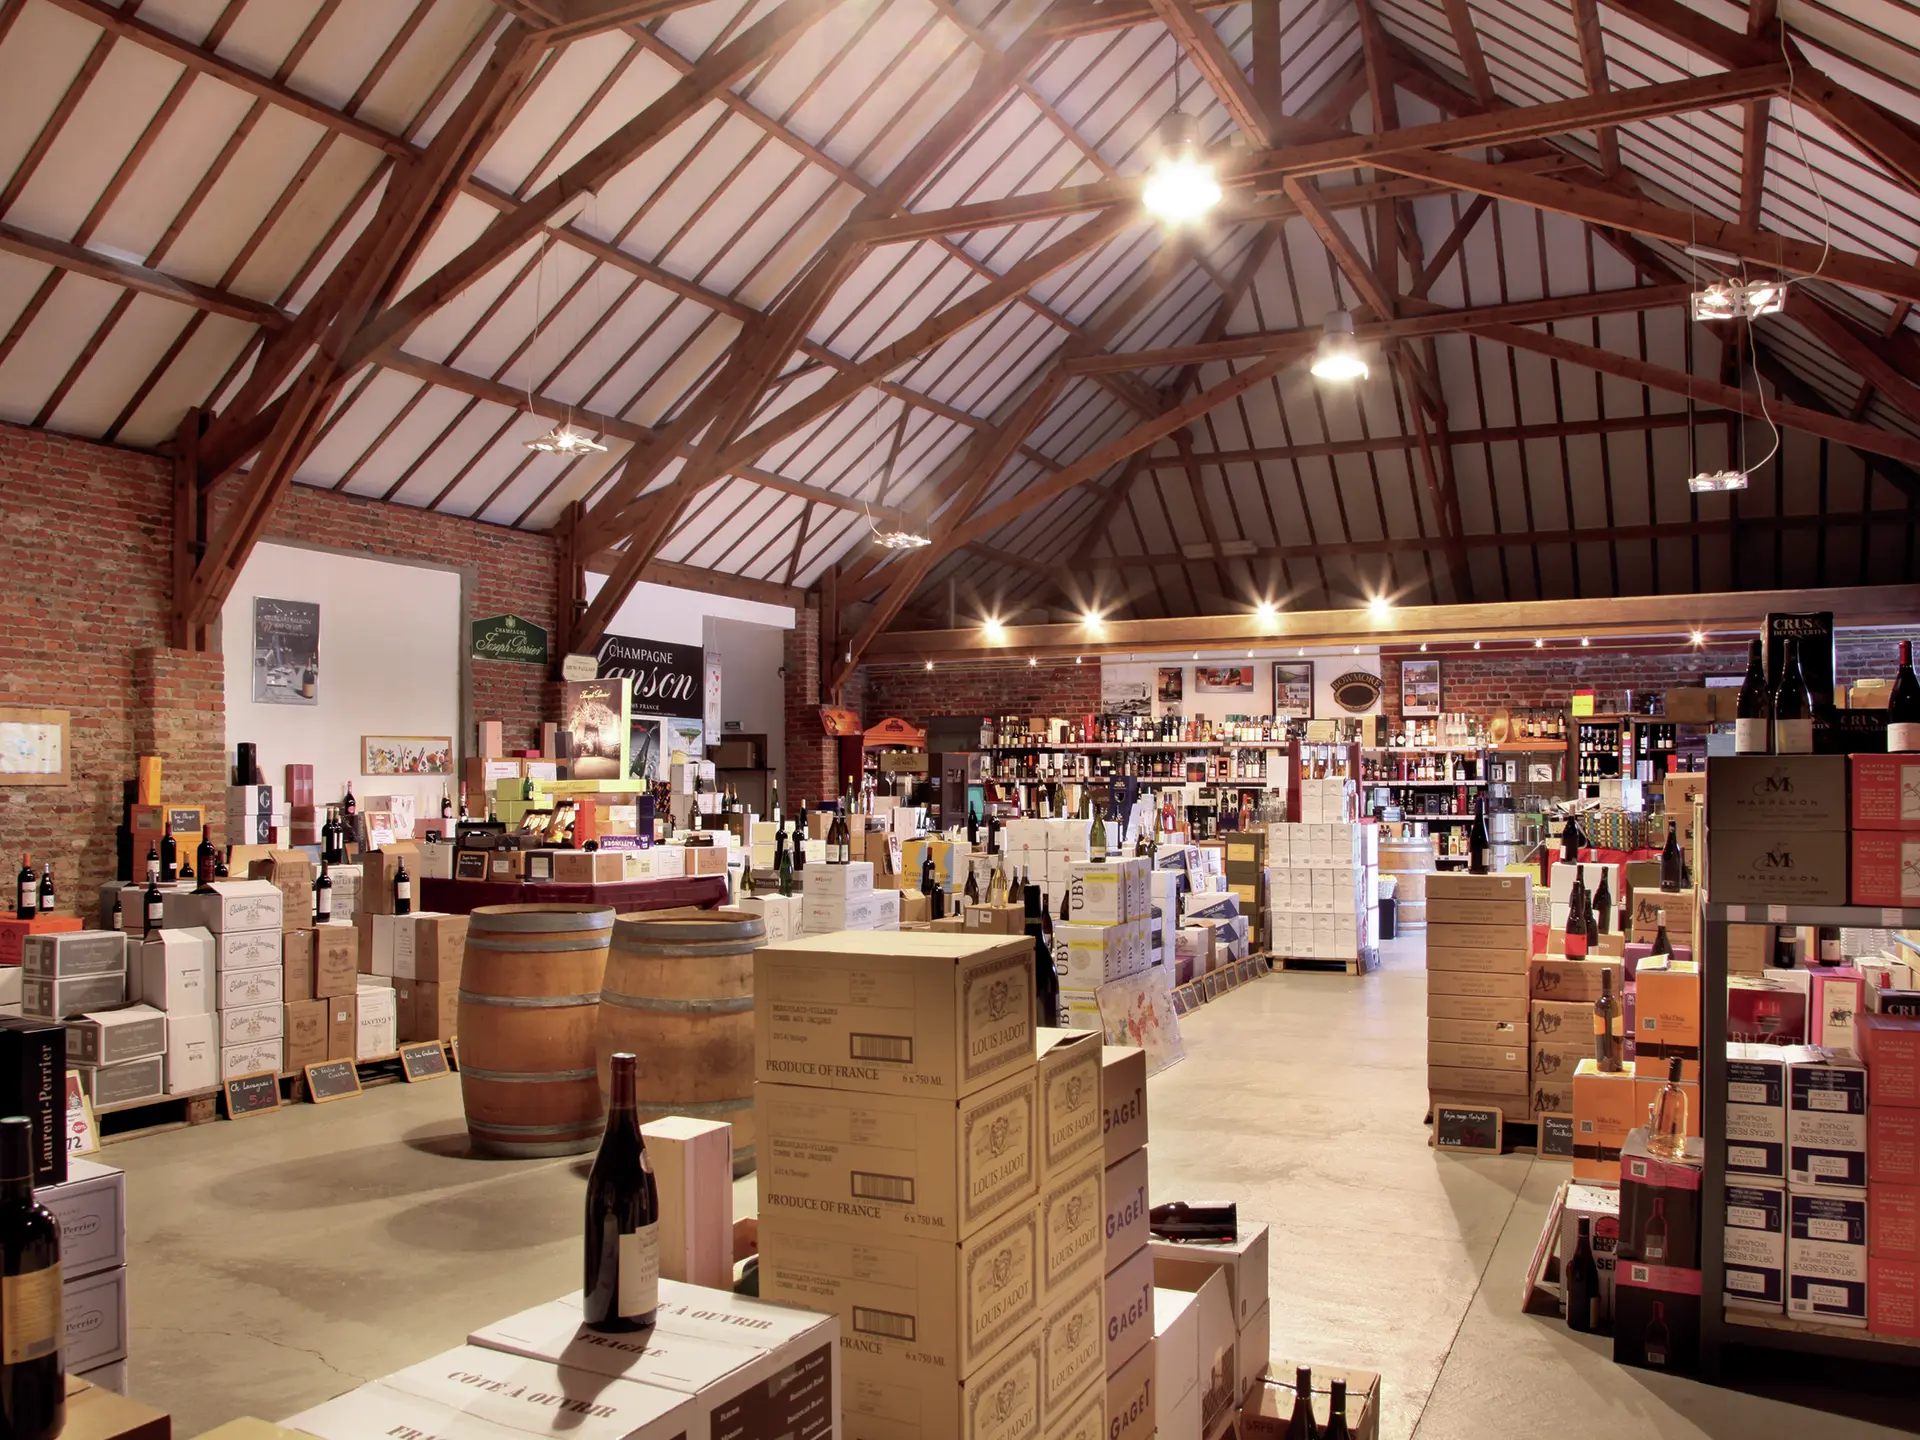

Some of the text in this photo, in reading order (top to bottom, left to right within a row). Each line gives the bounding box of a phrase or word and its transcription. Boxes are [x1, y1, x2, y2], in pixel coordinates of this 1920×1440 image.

[495, 627, 527, 636] CHAMPAGNE
[1773, 619, 1813, 630] CRUS
[476, 632, 544, 656] Joseph Perrier
[609, 644, 673, 664] CHAMPAGNE
[1332, 673, 1381, 690] BOWMORE
[1737, 874, 1819, 882] MARRENON
[1072, 874, 1085, 911] UBY
[1056, 940, 1069, 976] UBY
[1060, 1003, 1070, 1029] BY
[972, 1021, 1026, 1057] LOUIS JADOT
[1732, 1031, 1801, 1046] BUZET
[766, 1059, 879, 1081] PRODUCE OF FRANCE
[903, 1074, 908, 1083] 6
[915, 1074, 929, 1085] 750
[930, 1077, 944, 1086] ML
[39, 1045, 53, 1172] Laurent-Perrier
[1103, 1088, 1142, 1134] GAGET
[1052, 1109, 1096, 1147] LOUIS JADOT
[1818, 1122, 1850, 1131] ROUGE
[1794, 1134, 1857, 1147] ORTAS RESERVE
[973, 1152, 1025, 1197] LOUIS JADOT
[768, 1193, 881, 1219] PRODUCE OF FRANCE
[1105, 1186, 1145, 1240] GAGET
[63, 1221, 97, 1235] Perrier
[904, 1213, 909, 1223] 6
[916, 1213, 930, 1226] 750
[932, 1216, 946, 1228] ML
[1051, 1226, 1097, 1270] LOUIS JADOT
[1793, 1262, 1858, 1277] ORTAS RESERVE
[670, 1305, 689, 1316] À
[691, 1311, 774, 1330] OUVRIR
[975, 1280, 1029, 1334] LOUIS JADOT
[1108, 1283, 1150, 1342] GAGET
[66, 1316, 99, 1333] Perrier
[577, 1334, 668, 1358] FRAGILE
[840, 1336, 883, 1355] FRANCE
[906, 1351, 910, 1361] 6
[917, 1352, 932, 1365] 750
[933, 1356, 946, 1367] ML
[1052, 1340, 1098, 1391] LOUIS JADOT
[448, 1371, 617, 1419] CÔTÉ À OUVRIR
[1110, 1378, 1151, 1440] GAGET
[1006, 1408, 1034, 1440] JADOT
